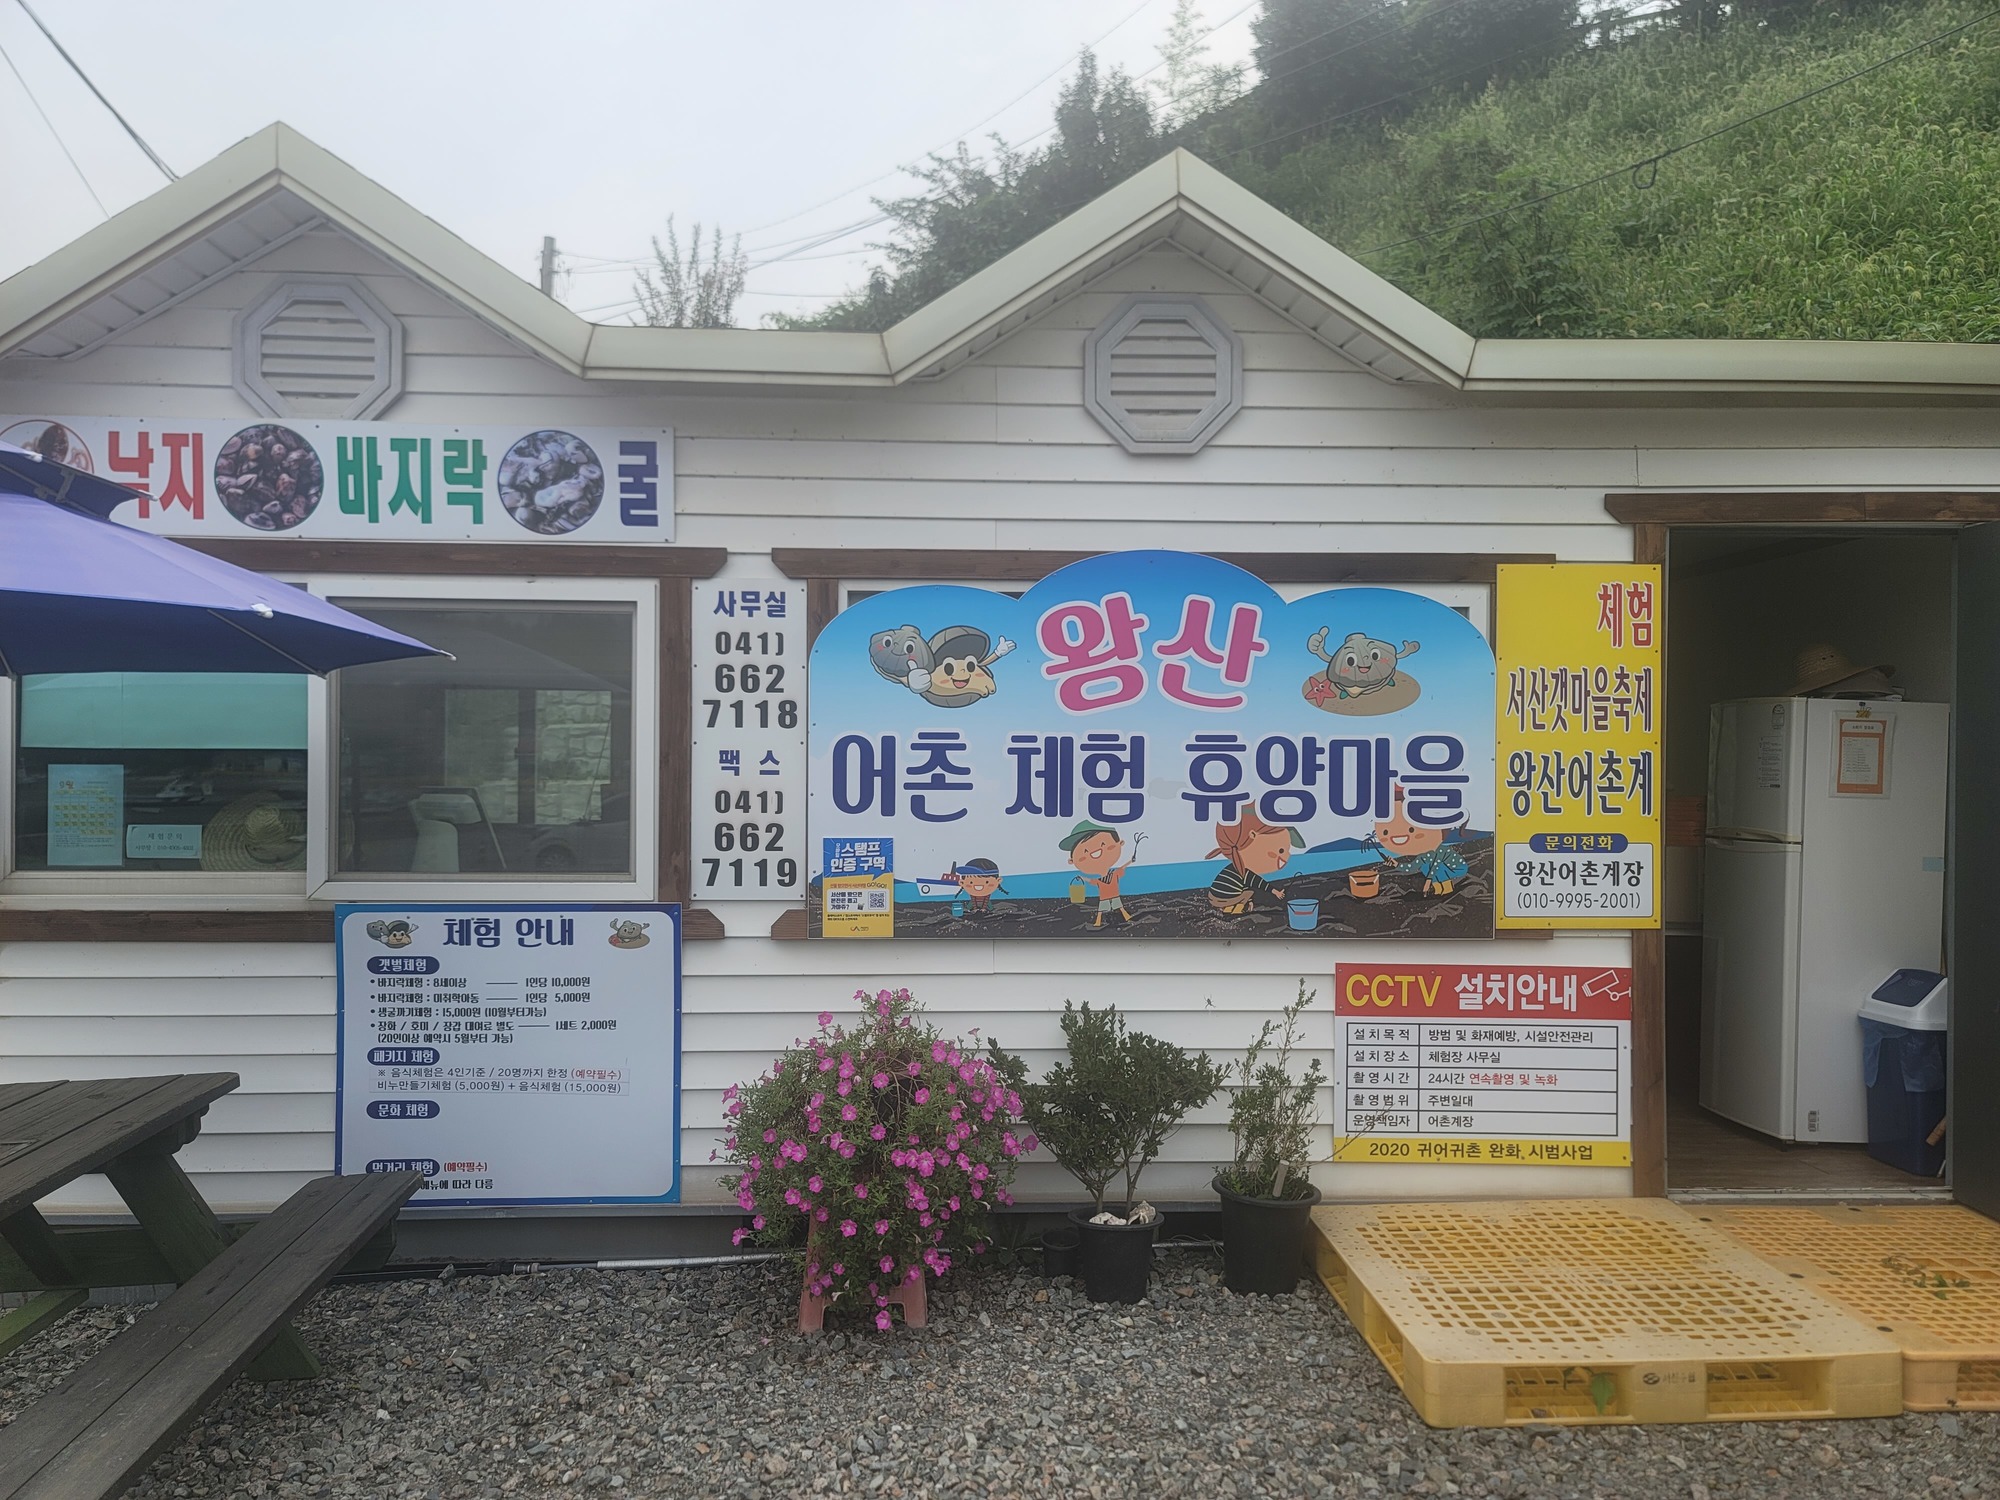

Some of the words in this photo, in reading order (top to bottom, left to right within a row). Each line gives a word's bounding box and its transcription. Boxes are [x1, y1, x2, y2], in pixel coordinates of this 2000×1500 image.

[108, 431, 204, 520] 낙지
[336, 436, 487, 524] 바지락
[618, 441, 660, 528] 굴
[714, 590, 787, 618] 사무실
[1598, 582, 1653, 647] 체험
[715, 631, 784, 656] 041)
[1038, 593, 1268, 713] 왕산
[715, 664, 785, 693] 662
[1506, 666, 1652, 733] 서산갯마을축제
[702, 700, 798, 729] 7118
[831, 731, 974, 822] 어촌
[1005, 733, 1146, 823] 체험
[1181, 733, 1470, 825] 휴양마을
[1505, 750, 1653, 817] 왕산어촌계
[715, 790, 784, 814] 041)
[714, 823, 784, 851] 662
[1544, 835, 1613, 851] 문의전화
[841, 842, 881, 857] 스탬프
[702, 858, 798, 887] 7119
[830, 858, 857, 873] 인증
[860, 856, 886, 872] 구역
[1514, 860, 1644, 887] 왕산어촌계장
[1517, 892, 1641, 909] (010-9995-2001)
[443, 917, 501, 948] 체험
[516, 918, 574, 948] 안내
[379, 958, 427, 972] 갯벌체험
[377, 977, 423, 988] 바지락체험
[433, 977, 467, 988] 8세이상
[551, 976, 591, 987] 10,000원
[377, 993, 423, 1003] 바지락체험
[433, 993, 479, 1004] 미취학아동
[554, 992, 591, 1003] 5,000원
[1346, 974, 1442, 1007] CCTV
[1454, 973, 1577, 1012] 설치안내
[377, 1007, 432, 1018] 생굴까기체험
[377, 1021, 396, 1031] 장화
[411, 1021, 429, 1031] 호미
[443, 1021, 462, 1031] 장갑
[465, 1021, 493, 1031] 대여료
[496, 1020, 515, 1031] 별도
[581, 1019, 617, 1030] 2,000원
[423, 1033, 451, 1044] 예약시
[454, 1033, 488, 1044] 5월부터
[491, 1033, 513, 1044] 가능)
[1428, 1029, 1451, 1041] 방범
[1456, 1029, 1466, 1041] 및
[1471, 1030, 1520, 1042] 화재예방,
[1525, 1031, 1593, 1043] 시설안전관리
[373, 1050, 406, 1063] 패키지
[411, 1050, 433, 1063] 체험
[1428, 1051, 1463, 1063] 체험장
[1466, 1051, 1501, 1063] 사무실
[391, 1067, 444, 1078] 음식체험은
[447, 1067, 486, 1077] 4인기준
[498, 1067, 543, 1078] 20명까지
[547, 1068, 568, 1078] 한정
[571, 1068, 622, 1080] (예약필수)
[1428, 1073, 1465, 1085] 24시간
[1469, 1072, 1514, 1086] 연속촬영
[1519, 1074, 1530, 1086] 및
[1534, 1074, 1558, 1086] 녹화
[377, 1081, 451, 1091] 비누만들기체험
[455, 1081, 505, 1091] (5,000원)
[518, 1081, 561, 1092] 음식체험
[564, 1082, 621, 1093] (15,000원)
[1428, 1095, 1474, 1107] 주변일대
[378, 1103, 401, 1117] 문화
[406, 1104, 429, 1117] 체험
[1353, 1114, 1410, 1127] 운영책임자
[1428, 1115, 1474, 1128] 어촌계장
[1369, 1142, 1410, 1156] 2020
[1417, 1142, 1482, 1158] 귀어귀촌
[1528, 1144, 1593, 1160] 시범사업
[443, 1162, 488, 1172] (예약필수)
[452, 1179, 472, 1190] 따라
